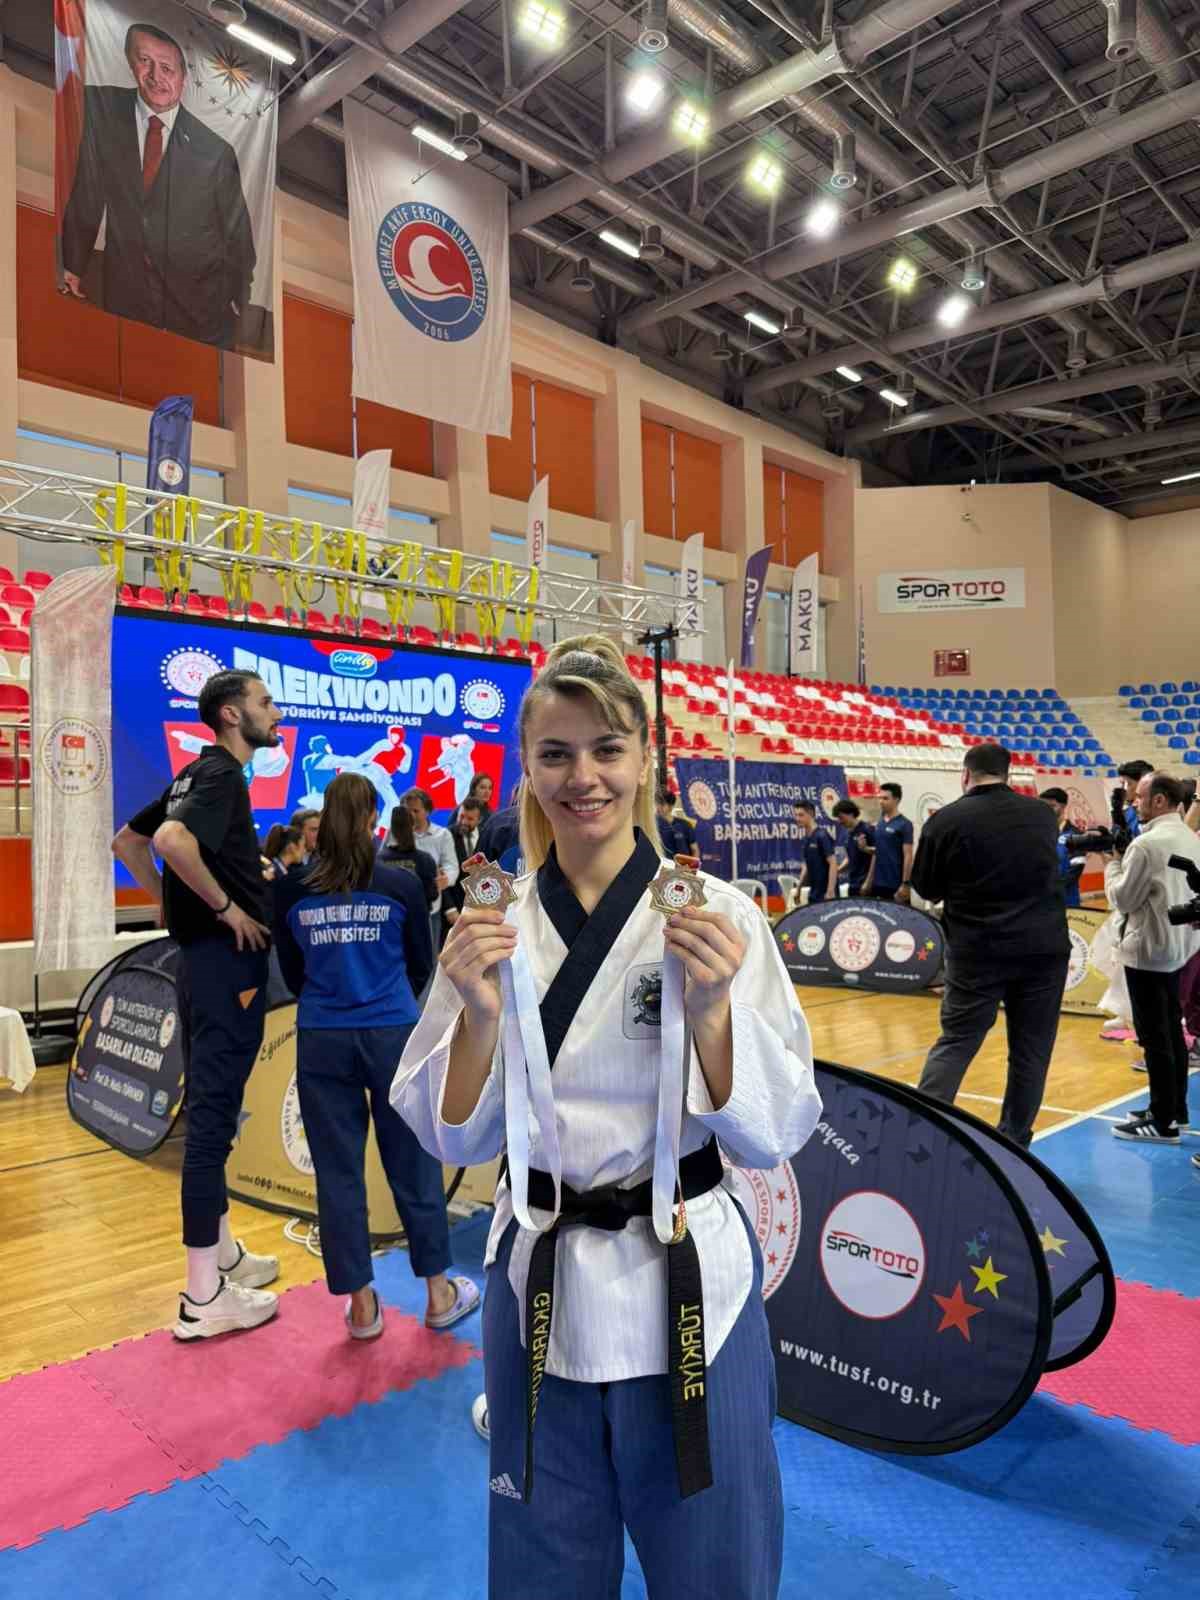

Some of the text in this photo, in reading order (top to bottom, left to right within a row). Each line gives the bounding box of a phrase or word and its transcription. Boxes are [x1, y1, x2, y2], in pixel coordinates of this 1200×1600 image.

[387, 206, 409, 233] AKİF
[411, 205, 450, 227] ERSOY
[379, 230, 401, 291] MEHMET
[798, 588, 813, 651] MAKÜ
[234, 647, 456, 717] TAEKWONDO
[281, 704, 422, 727] TÜRKİYE ŞAMPİYONASI
[744, 782, 801, 800] ANTRENÖR
[802, 786, 817, 800] VE
[353, 900, 369, 922] AKİF
[369, 904, 391, 922] ERSOY
[816, 1120, 861, 1166] ayata
[779, 1338, 942, 1410] www.tusf.org.tr
